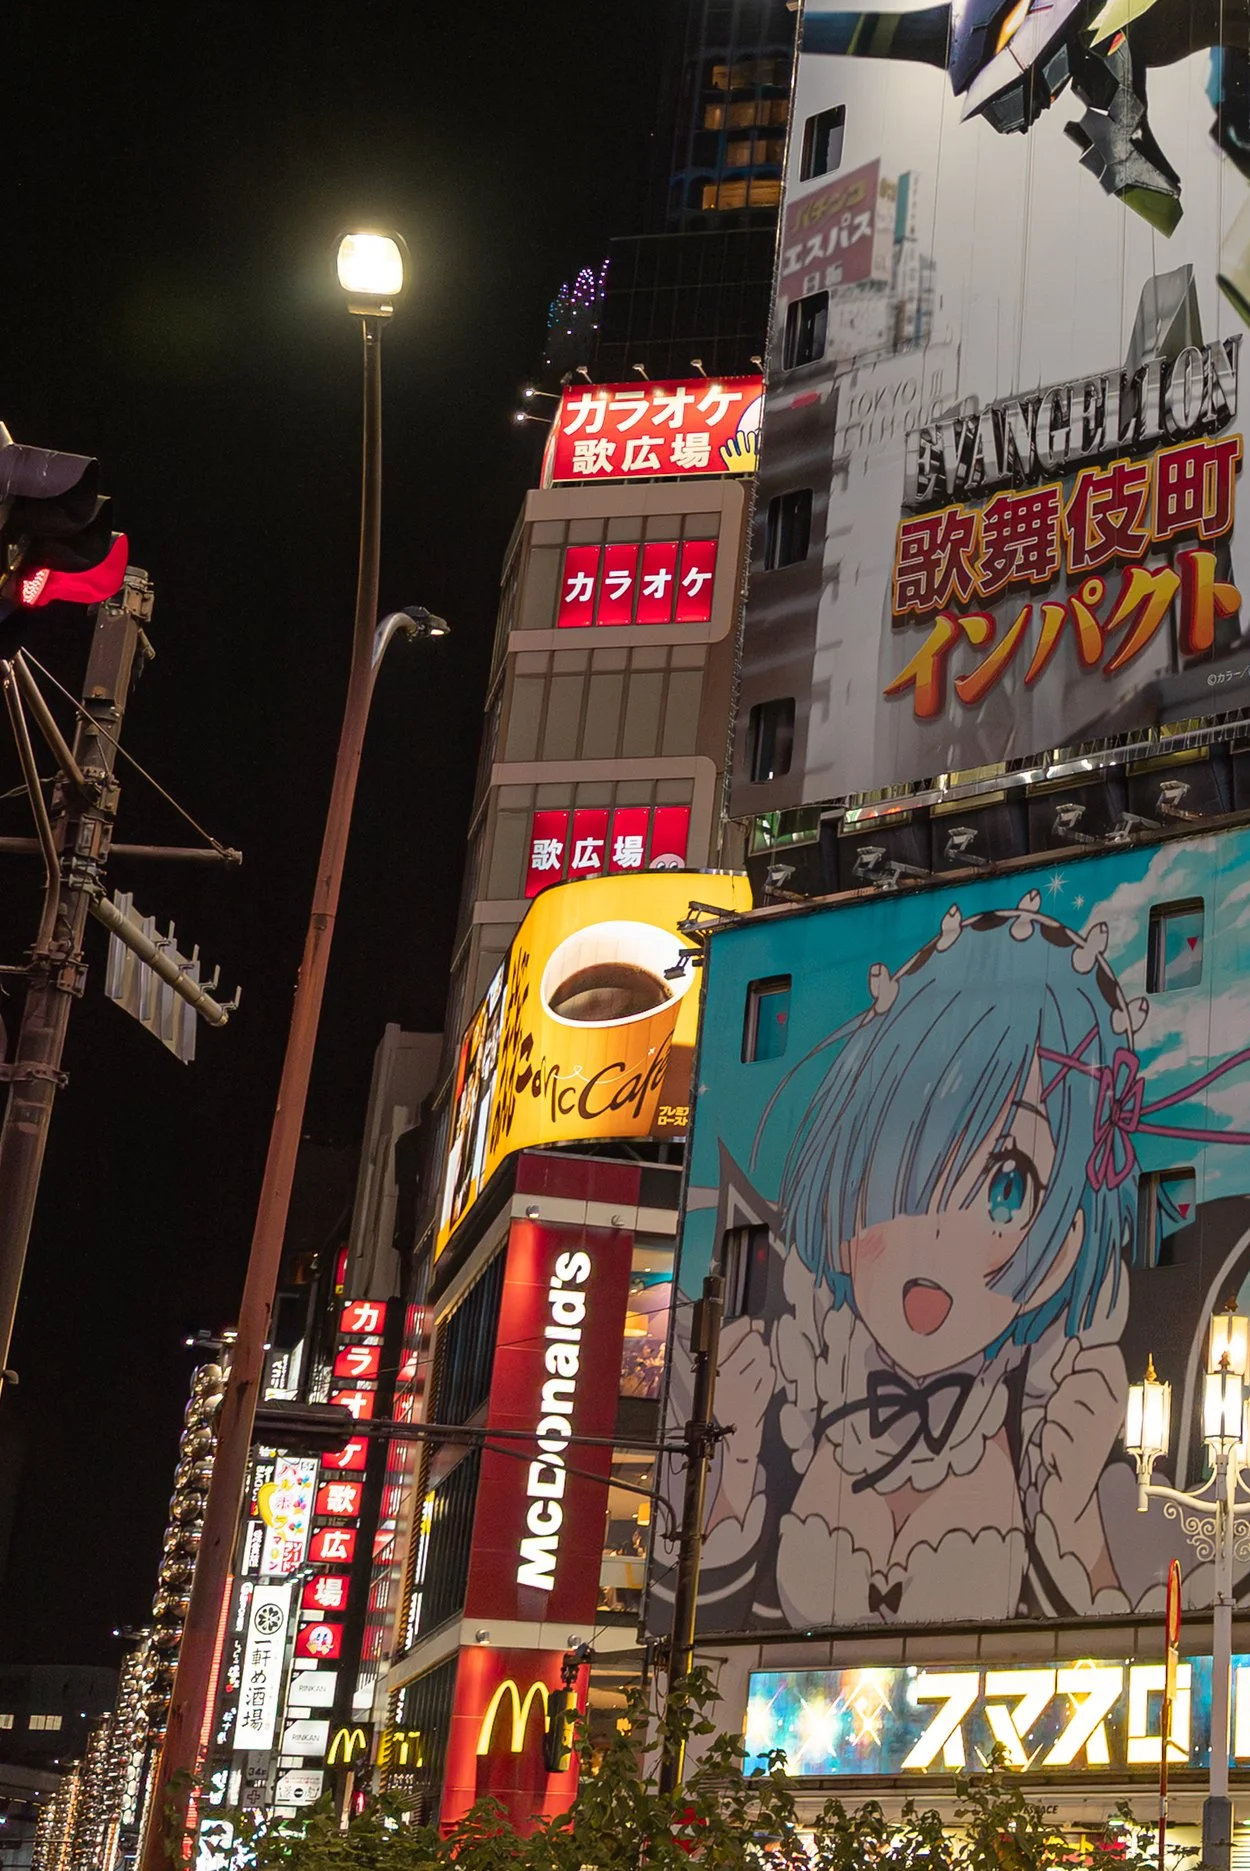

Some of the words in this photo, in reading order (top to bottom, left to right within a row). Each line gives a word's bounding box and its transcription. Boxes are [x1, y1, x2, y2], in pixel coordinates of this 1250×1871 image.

[782, 209, 872, 278] エスパス
[563, 384, 744, 435] カラオケ
[572, 431, 712, 476] 歌広場
[903, 334, 1243, 508] EVANGELION
[892, 433, 1243, 616] 歌舞伎町
[565, 566, 713, 604] カラオケ
[884, 549, 1242, 718] インパクト
[531, 835, 644, 872] 歌広場
[516, 1250, 592, 1592] McDonald's
[241, 1638, 272, 1732] 一軒め酒場
[900, 1663, 1192, 1770] スマスロ
